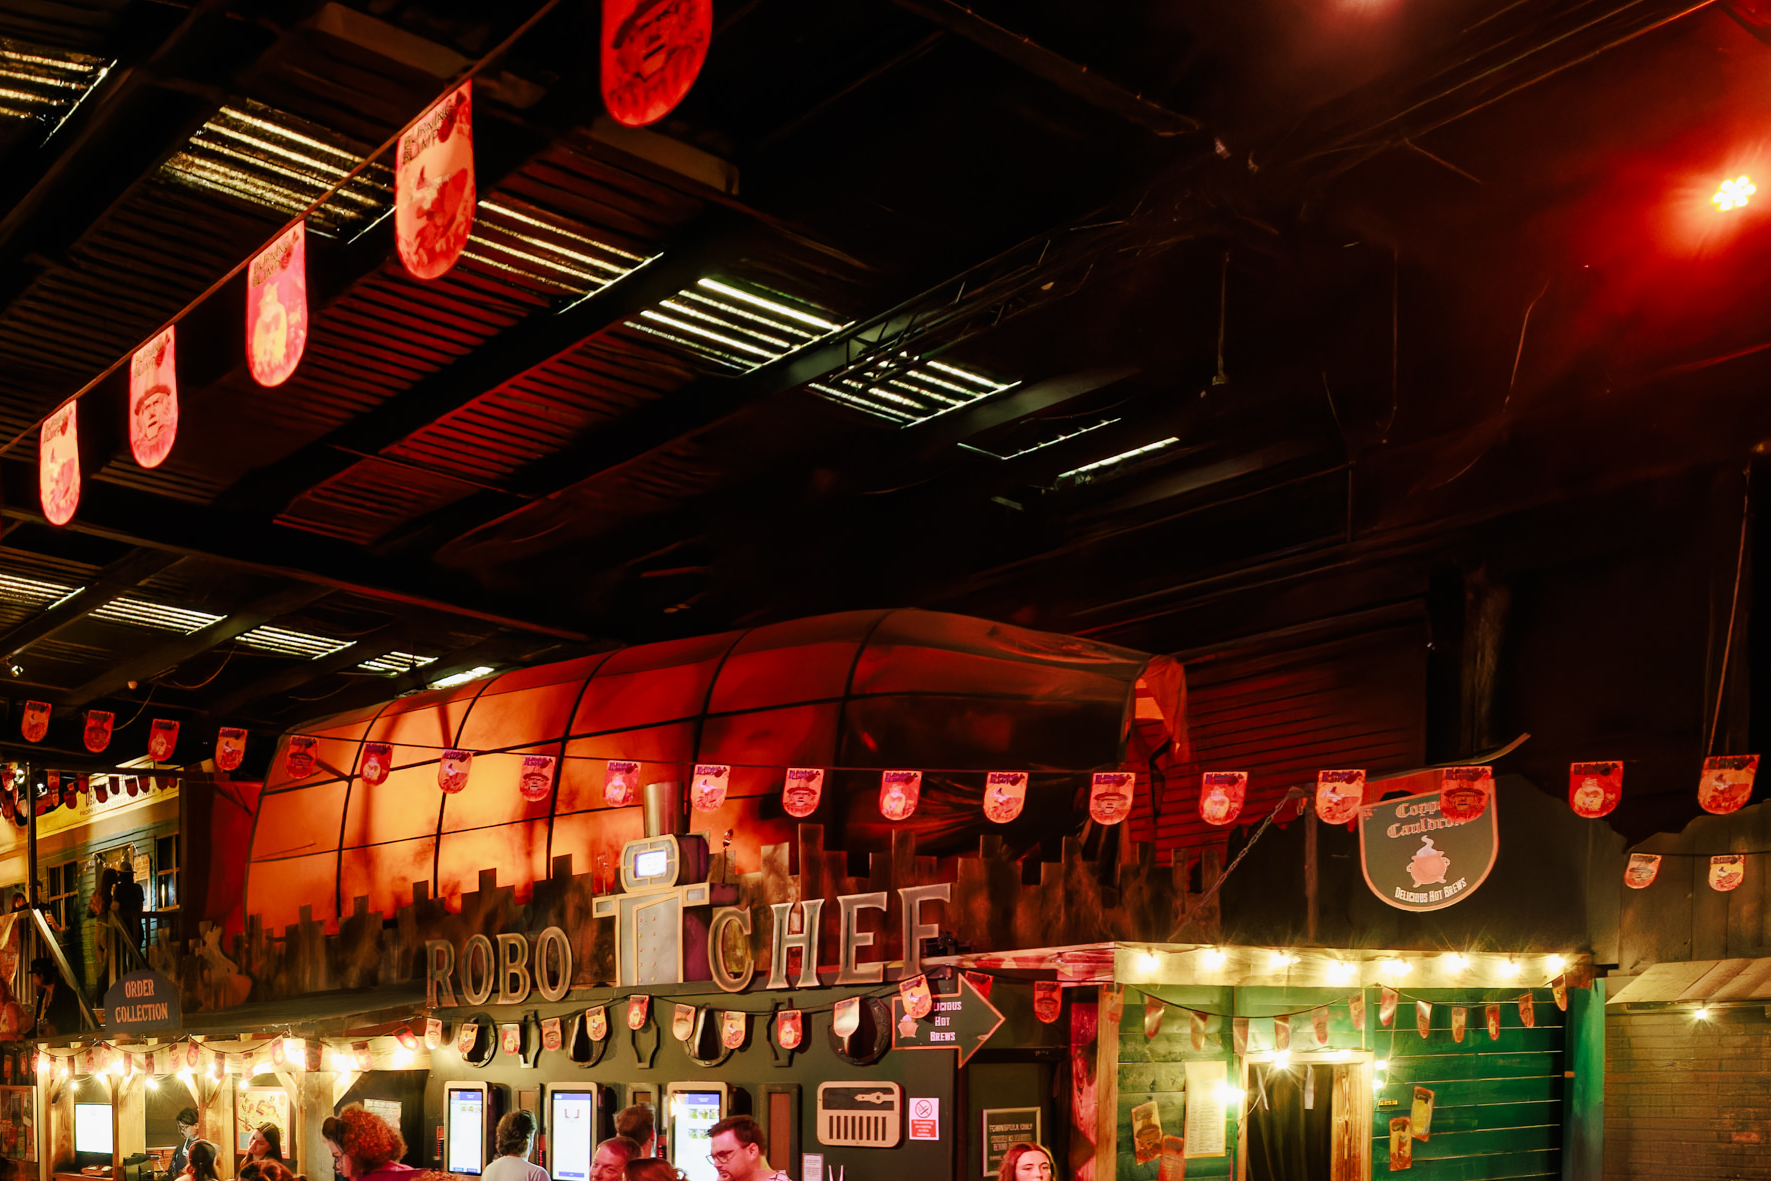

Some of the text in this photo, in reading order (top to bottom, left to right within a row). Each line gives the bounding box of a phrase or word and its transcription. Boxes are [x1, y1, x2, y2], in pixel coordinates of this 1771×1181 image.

[1395, 800, 1441, 818] Copp
[1394, 877, 1467, 903] DELICIOUS HOT BREWS
[708, 883, 951, 992] CHEF
[124, 978, 155, 998] ORDER
[115, 1002, 168, 1023] COLLECTION
[932, 1001, 962, 1011] LICIOUS
[934, 1016, 951, 1027] HOT
[930, 1032, 956, 1041] BREWS
